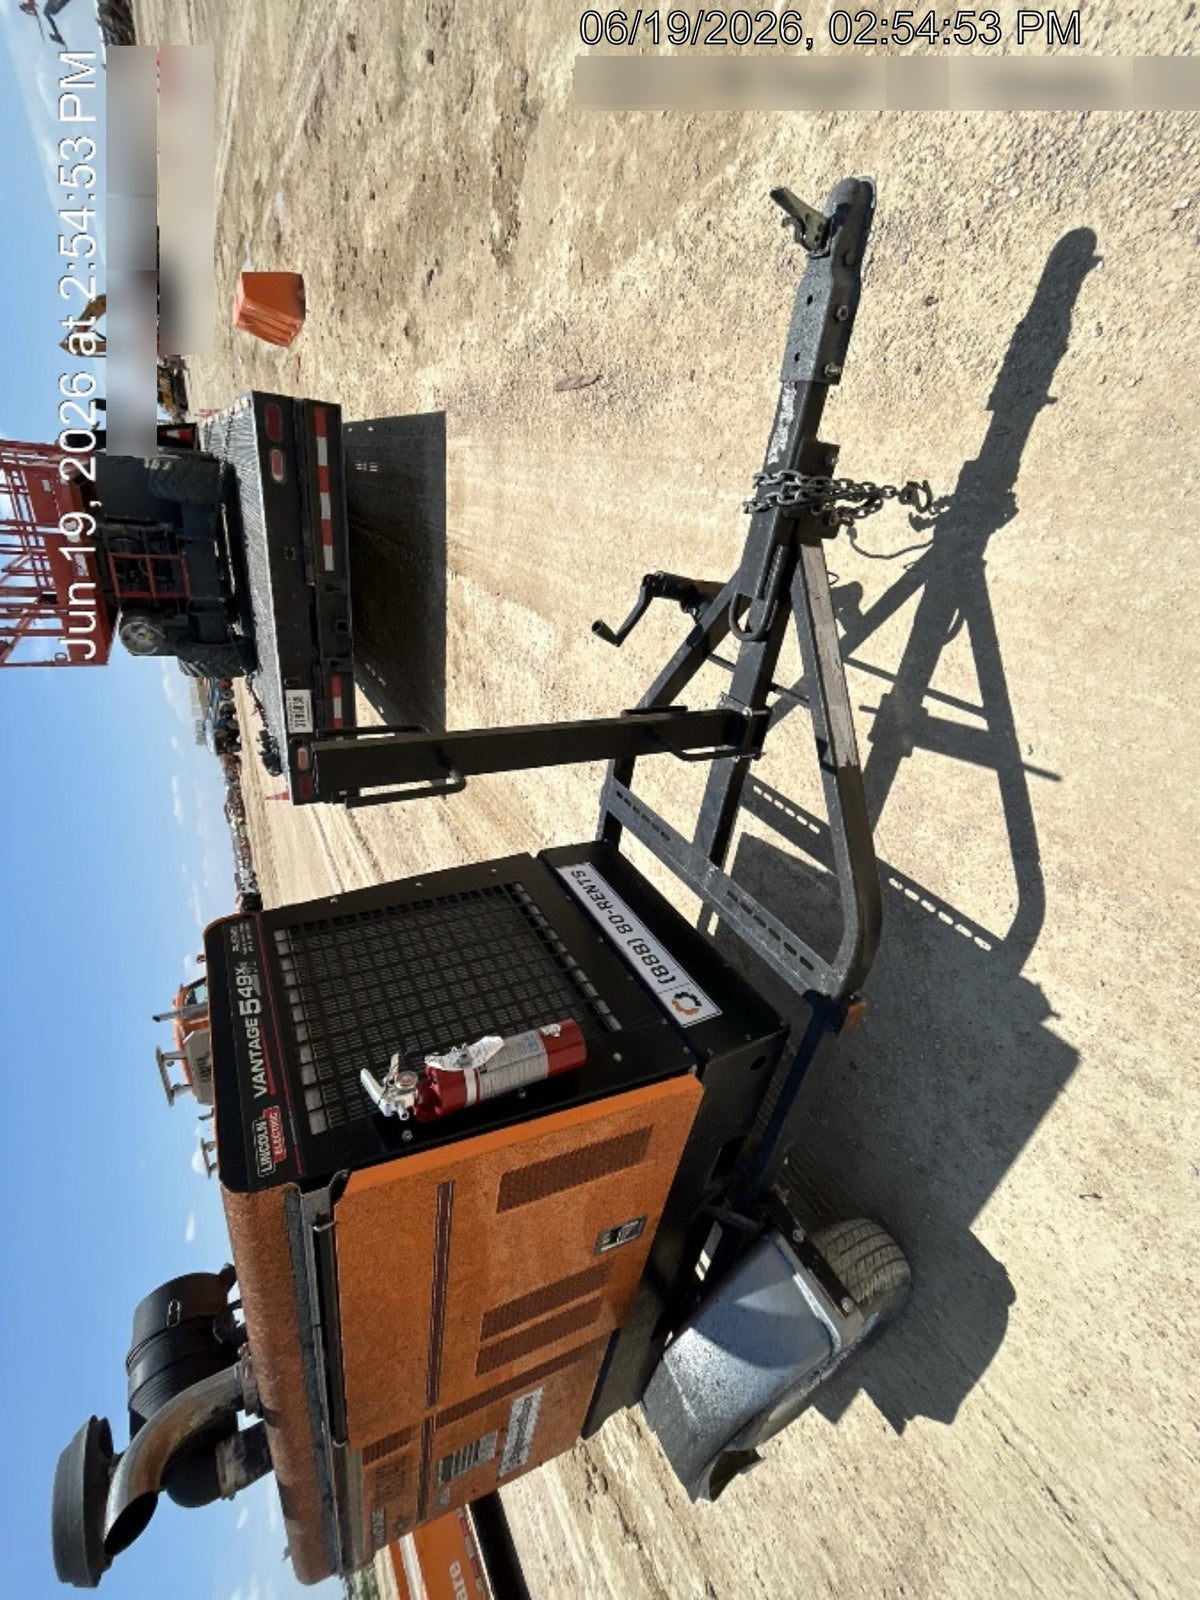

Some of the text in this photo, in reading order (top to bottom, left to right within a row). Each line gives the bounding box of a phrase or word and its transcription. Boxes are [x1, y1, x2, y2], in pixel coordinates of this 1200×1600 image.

[570, 869, 676, 985] (888) 80-RENTS
[244, 1017, 268, 1099] VANTAGE
[255, 1120, 273, 1174] LINCOLN
[269, 1111, 282, 1156] ELECTRIC
